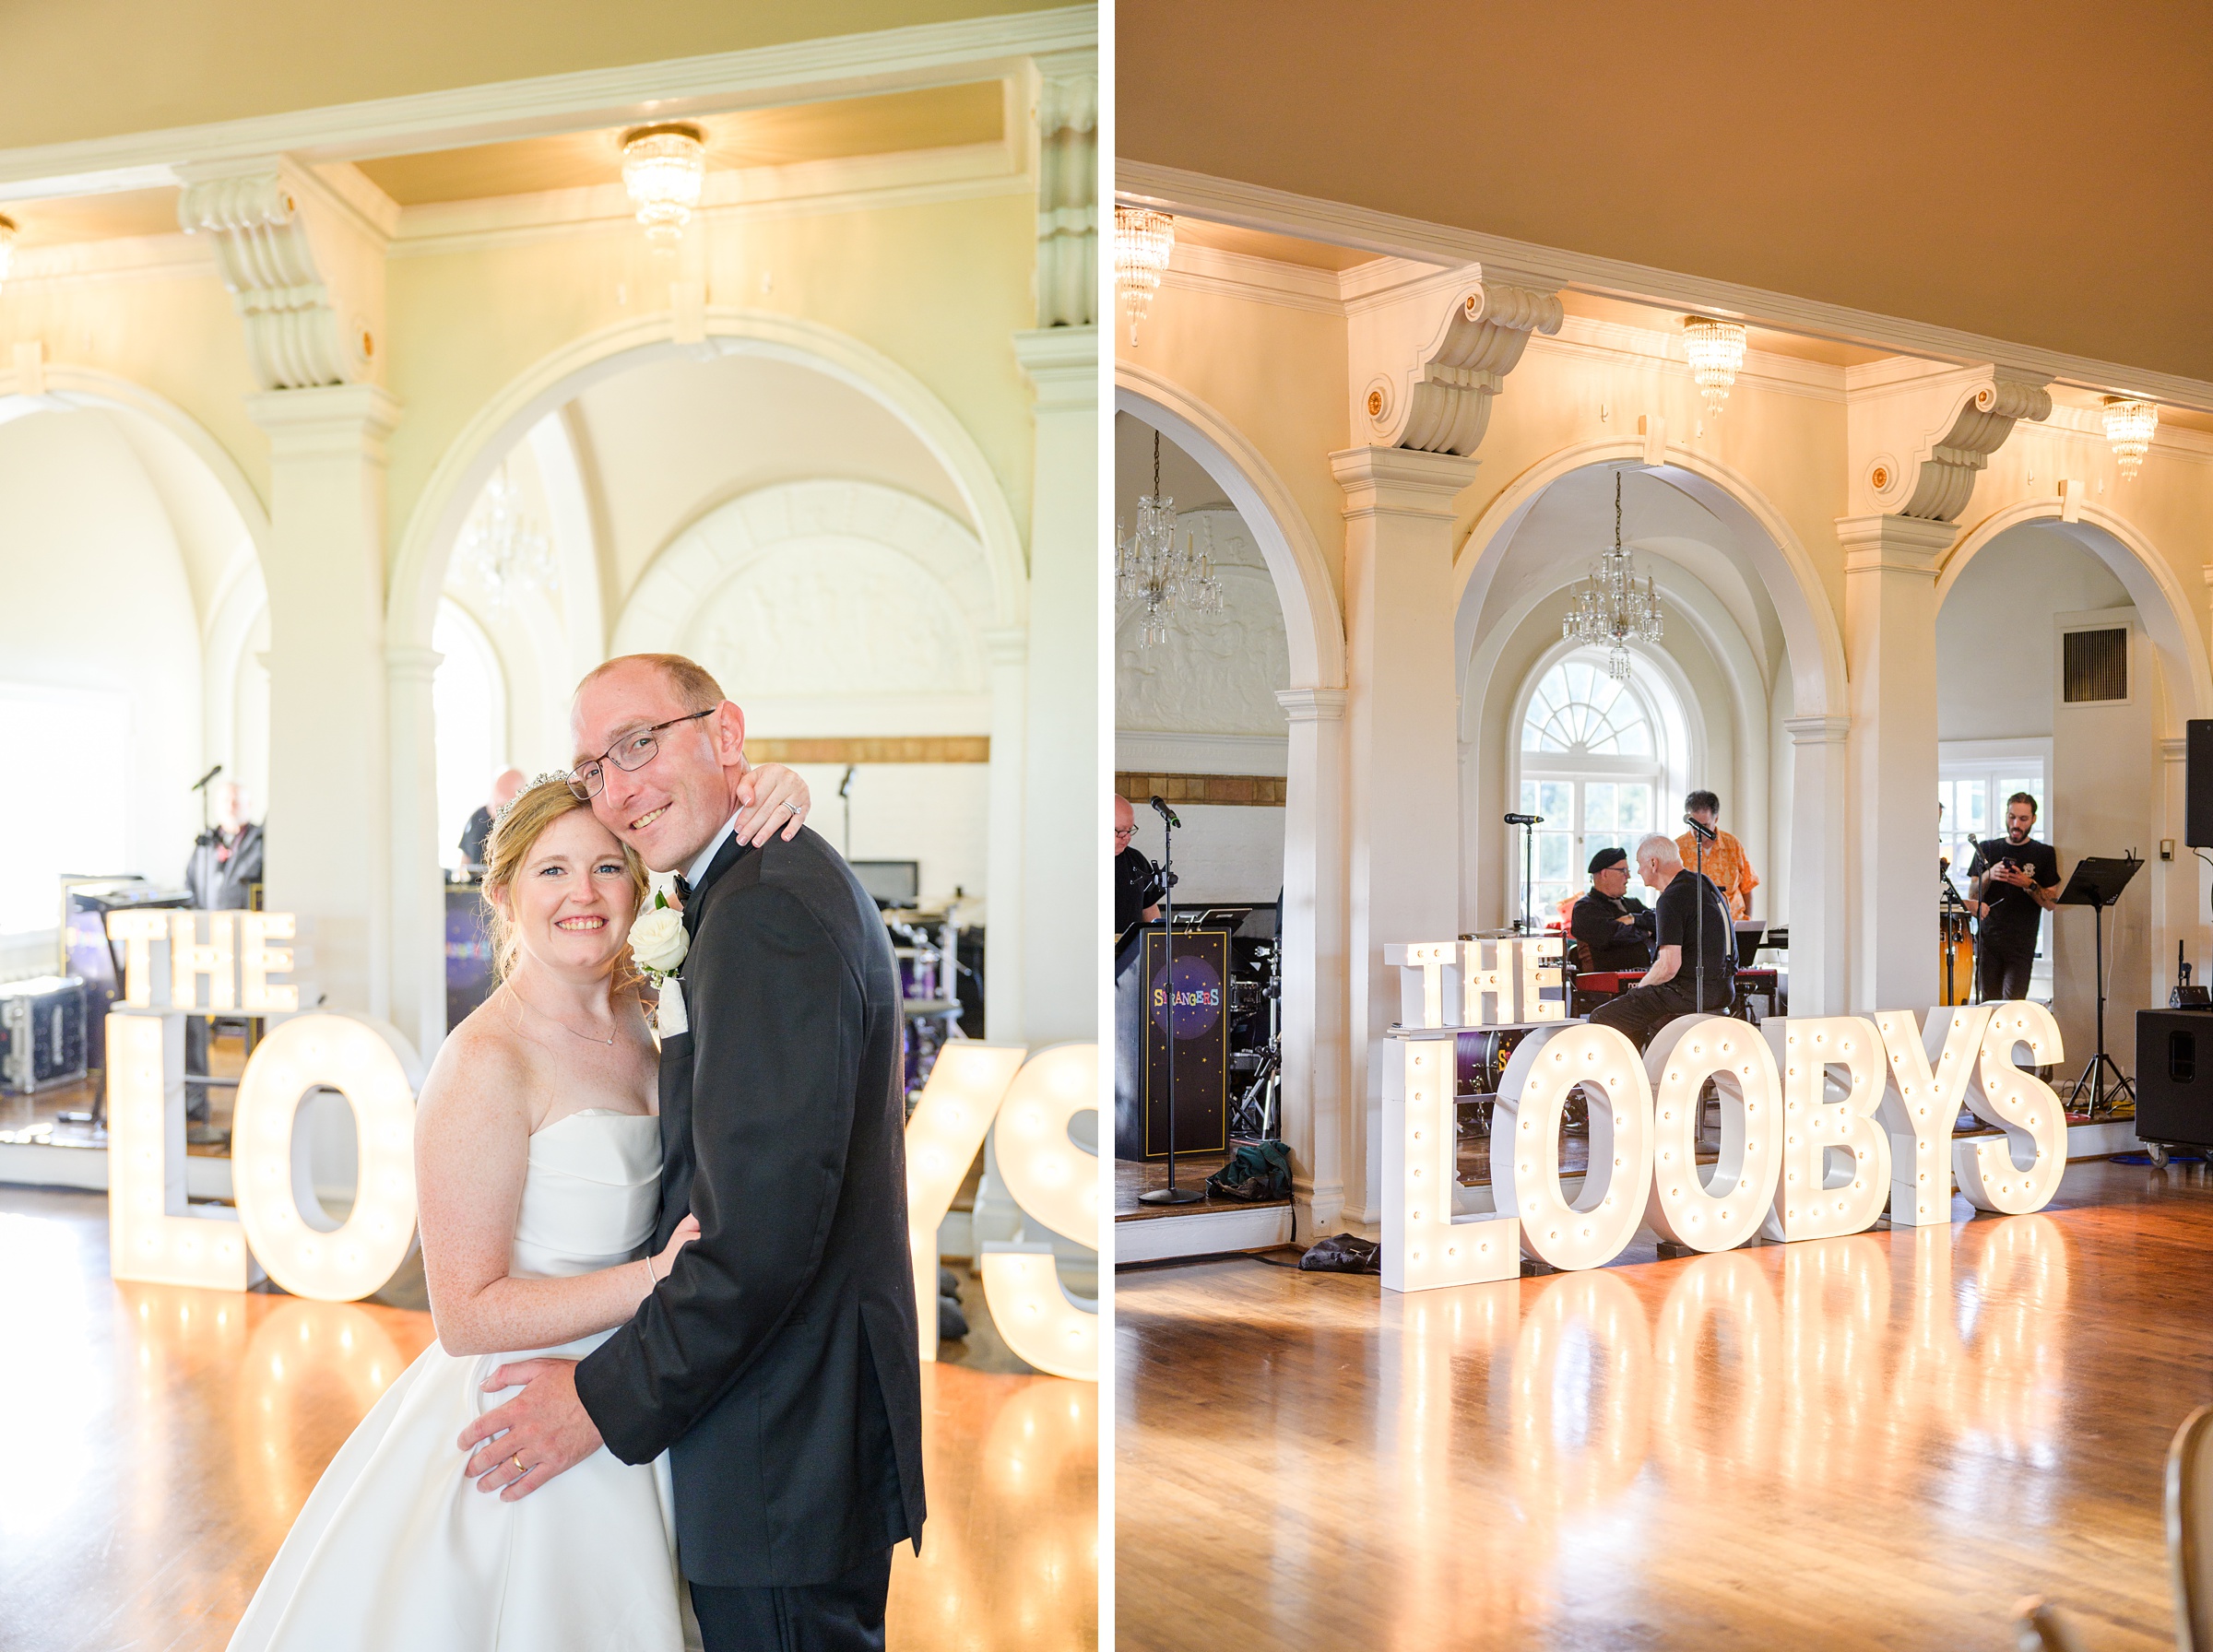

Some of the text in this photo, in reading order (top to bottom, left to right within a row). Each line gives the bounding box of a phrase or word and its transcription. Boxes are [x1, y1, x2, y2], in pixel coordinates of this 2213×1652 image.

[106, 911, 299, 1012] THE
[1384, 938, 1565, 1029] THE
[1381, 1000, 2067, 1292] LOOBYS
